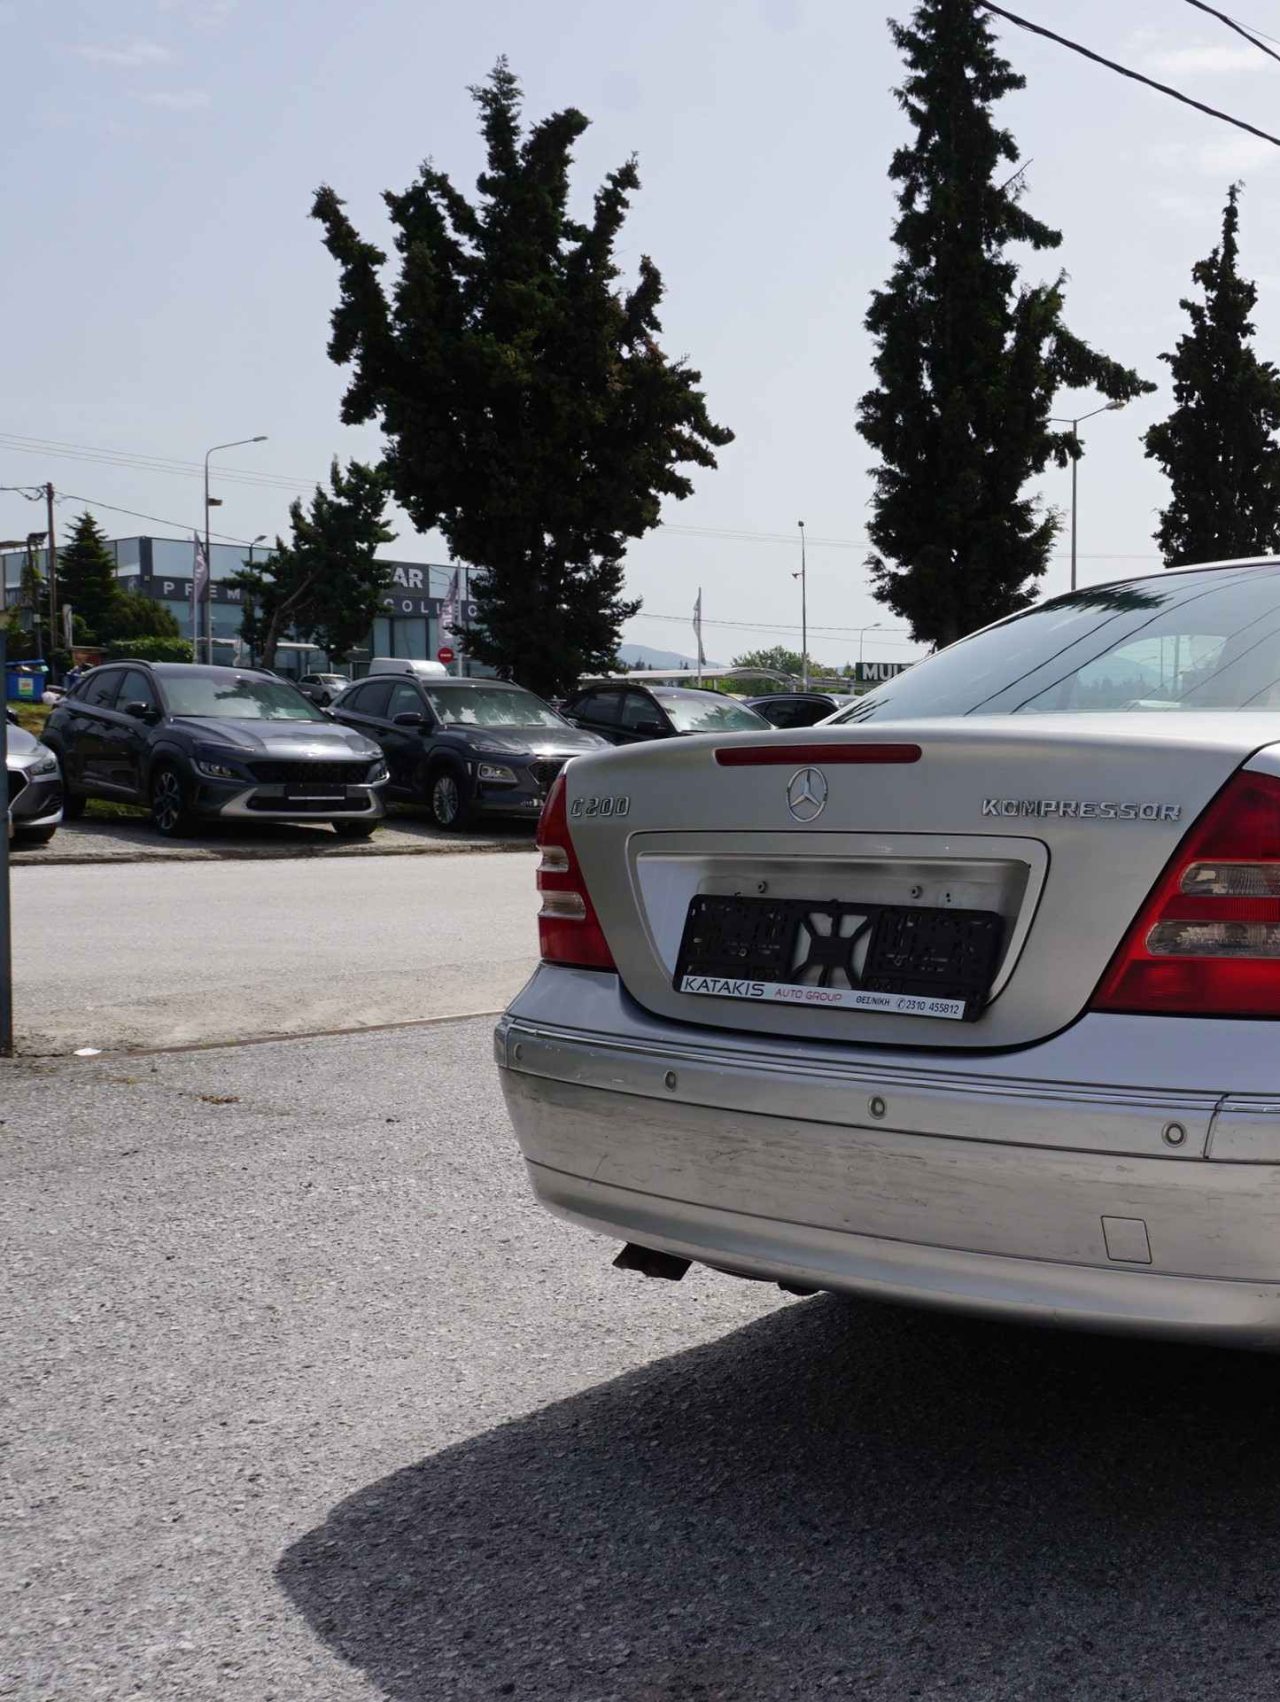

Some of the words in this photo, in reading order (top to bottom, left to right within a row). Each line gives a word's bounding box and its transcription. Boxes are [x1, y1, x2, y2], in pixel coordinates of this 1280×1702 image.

[981, 799, 1183, 821] KOMPRESSOR
[684, 977, 765, 997] KATAKIS
[774, 988, 803, 999] AUTO
[805, 991, 842, 1002] GROUP
[906, 1000, 926, 1011] 2310
[928, 1002, 960, 1014] 455812
